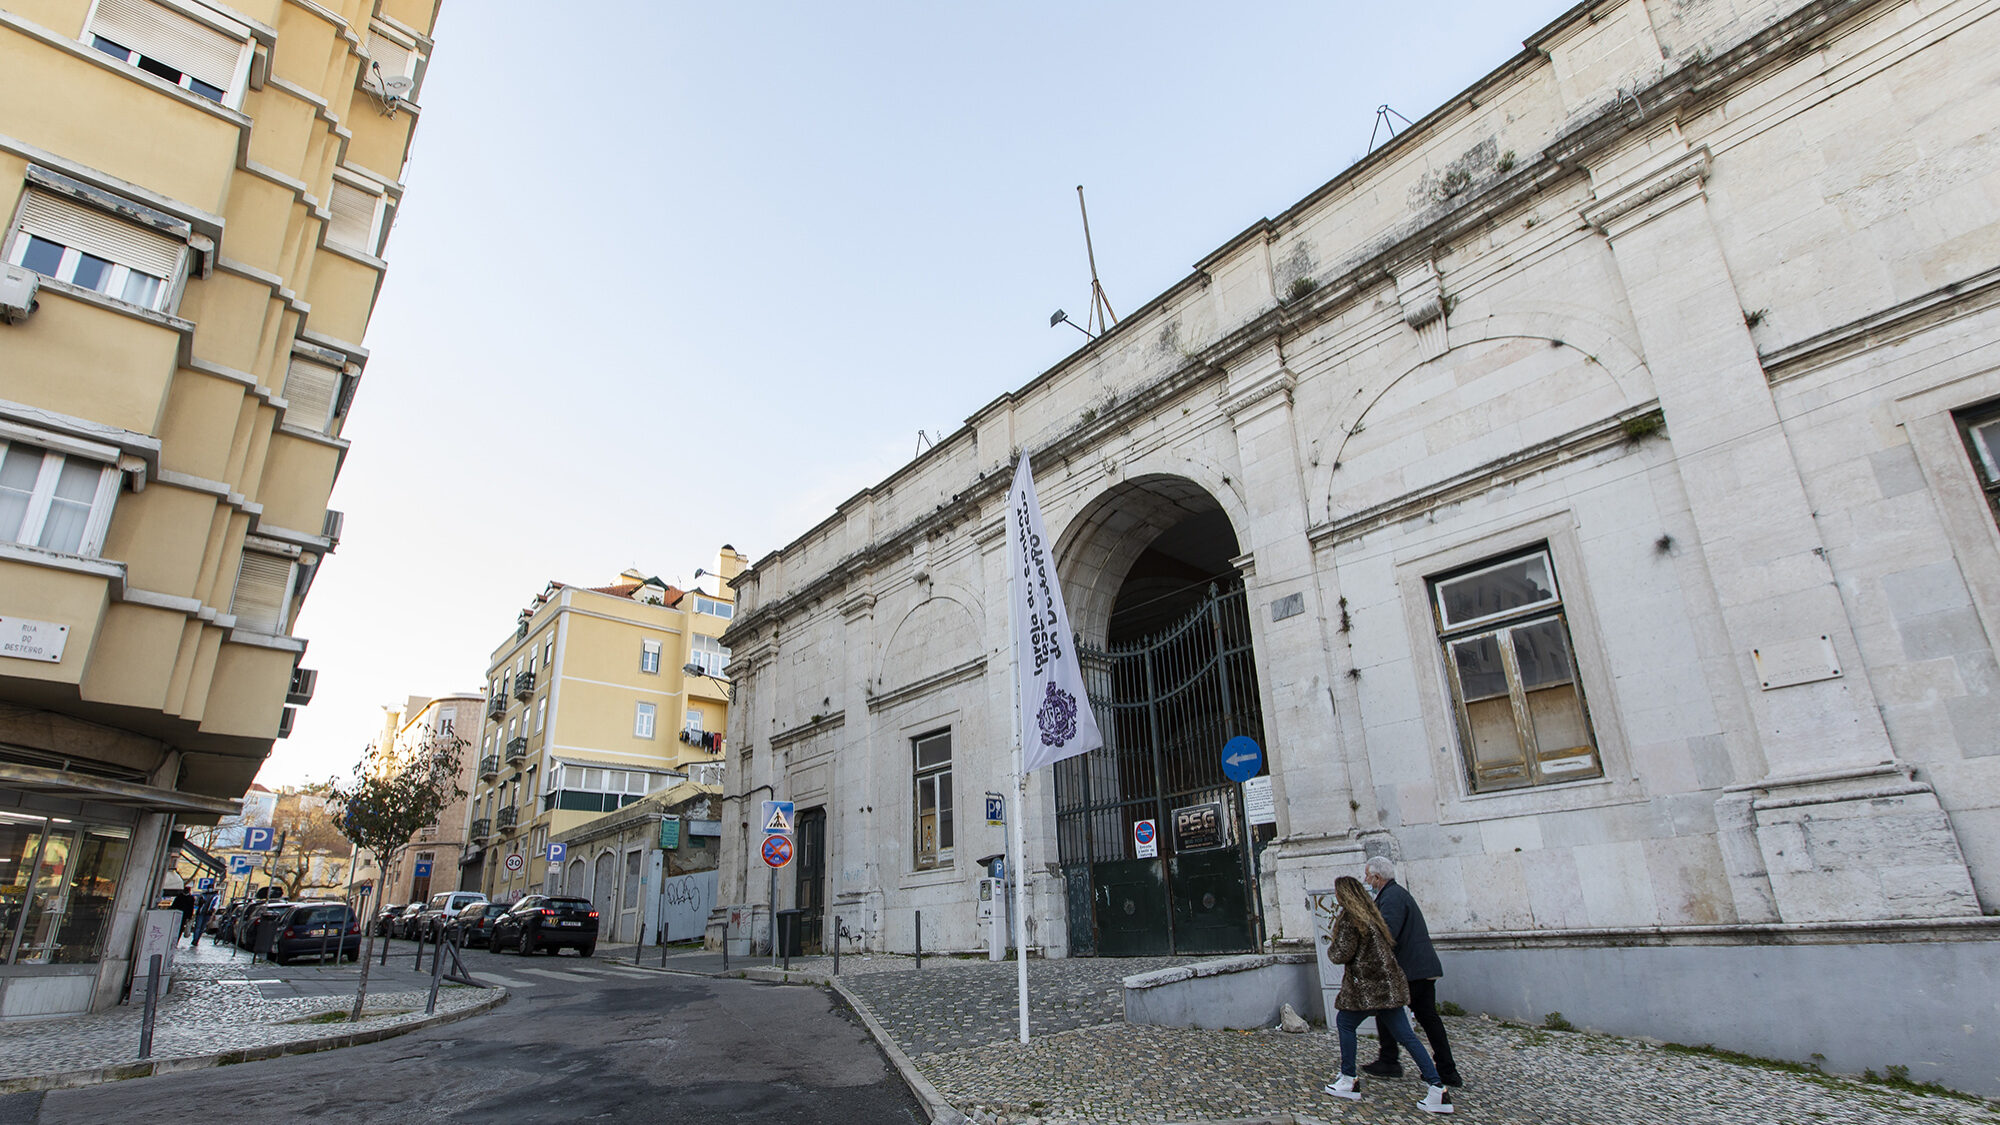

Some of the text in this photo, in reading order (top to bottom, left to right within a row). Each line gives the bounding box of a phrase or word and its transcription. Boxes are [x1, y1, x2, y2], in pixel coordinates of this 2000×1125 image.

[1026, 581, 1034, 609] do
[22, 624, 37, 633] RUA
[22, 635, 33, 643] DO
[4, 643, 43, 655] DESTERRO
[988, 800, 996, 819] P
[1178, 810, 1216, 833] PSG
[249, 829, 268, 849] P
[550, 844, 562, 860] P
[233, 857, 247, 873] P
[508, 859, 521, 867] 30
[996, 863, 1003, 874] P
[201, 878, 211, 889] P
